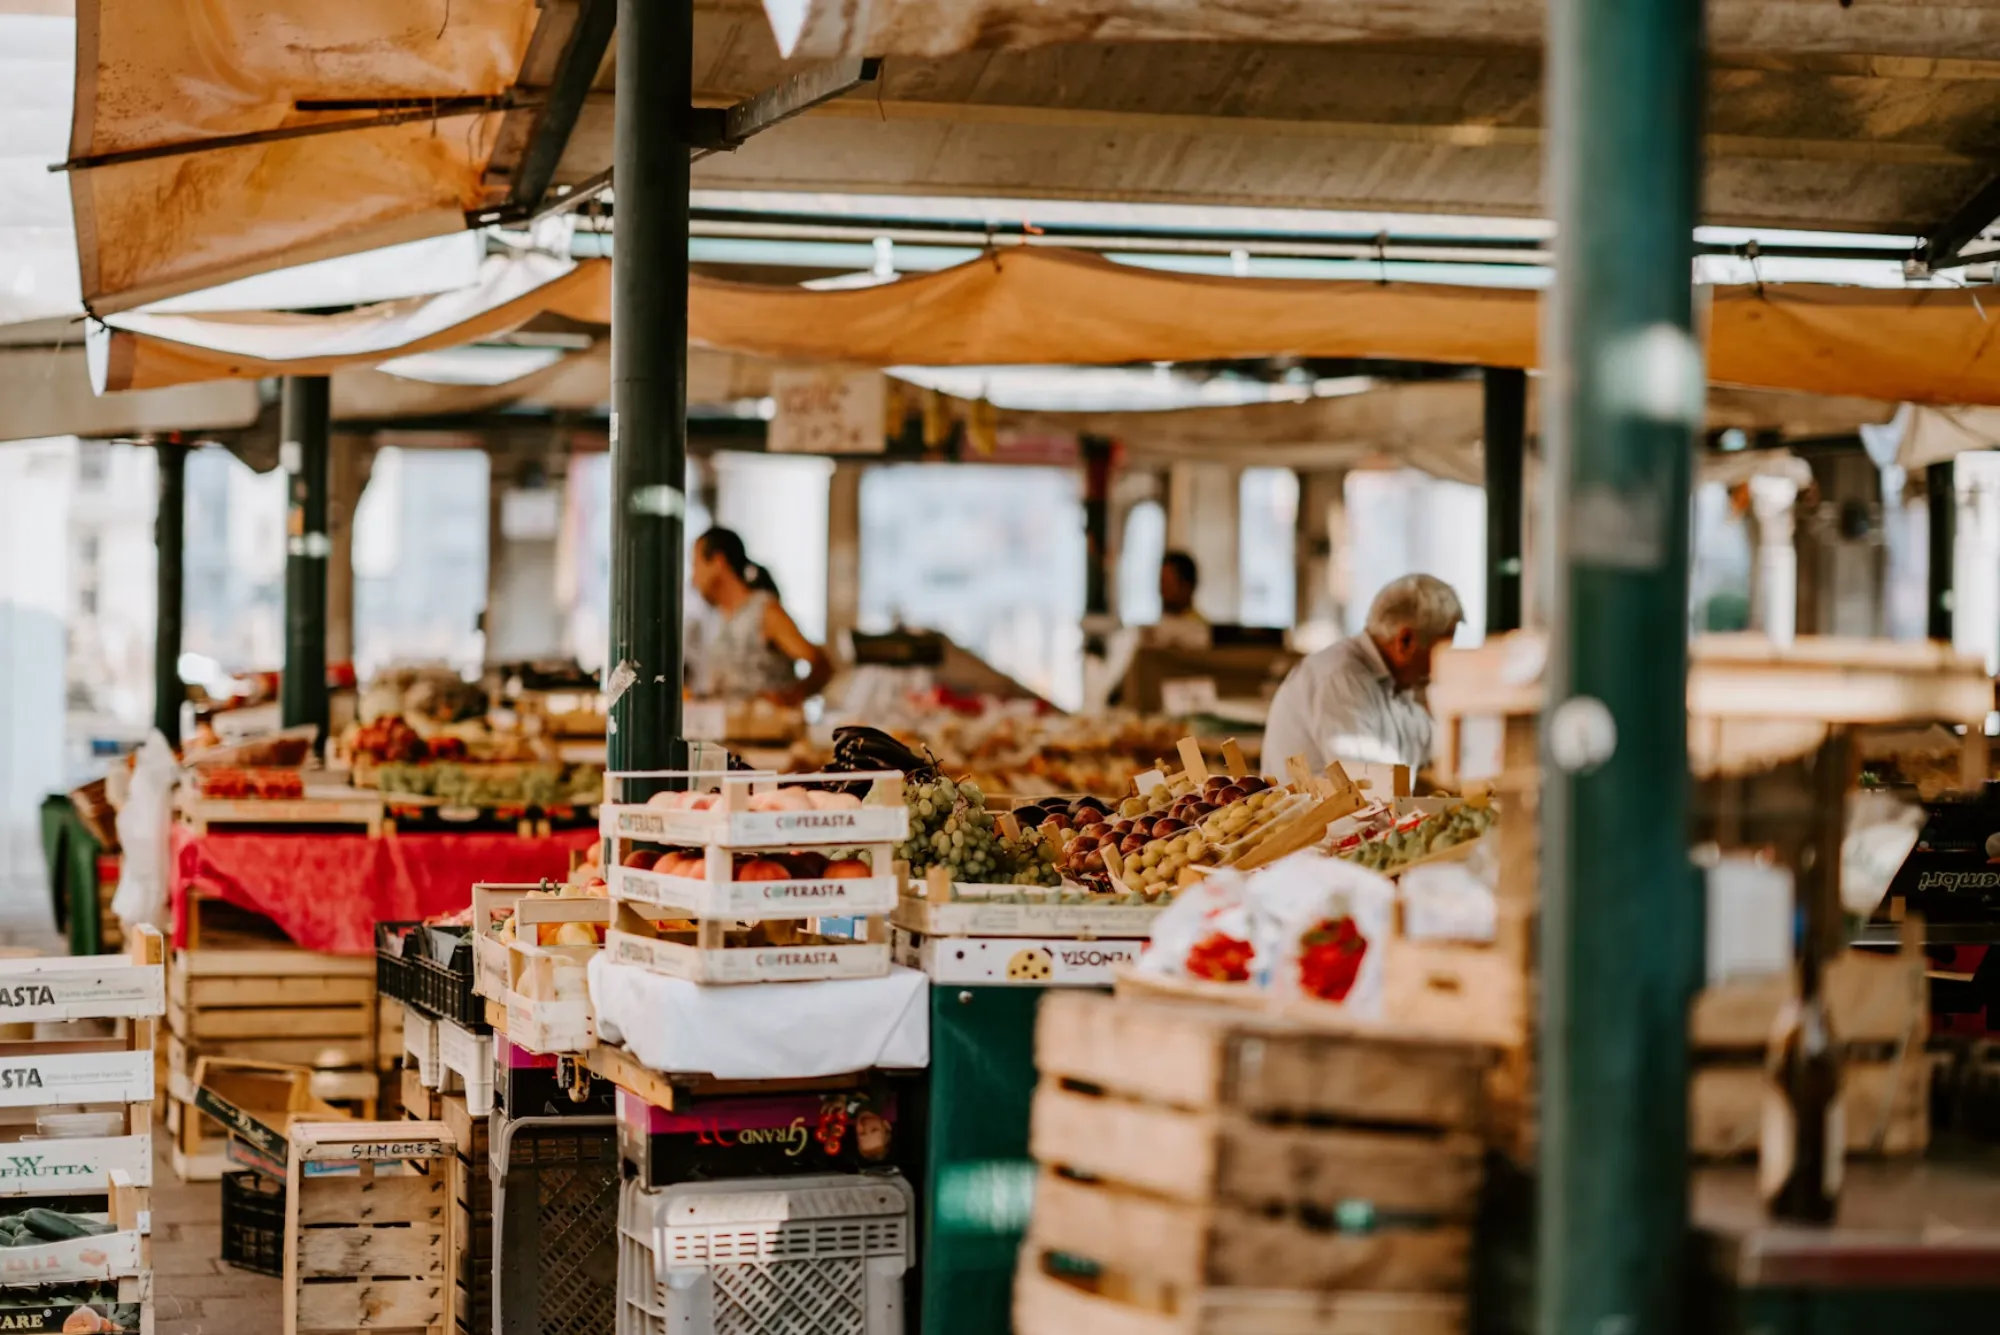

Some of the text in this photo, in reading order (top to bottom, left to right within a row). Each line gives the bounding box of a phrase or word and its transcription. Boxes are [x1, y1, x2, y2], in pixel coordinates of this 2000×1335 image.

[776, 814, 856, 830] COFERASTA
[763, 884, 845, 898] COFERASTA
[756, 952, 839, 966] COFERASTA
[0, 985, 55, 1007] ASTA
[739, 1117, 808, 1156] GRAND
[0, 1314, 44, 1329] ARE
